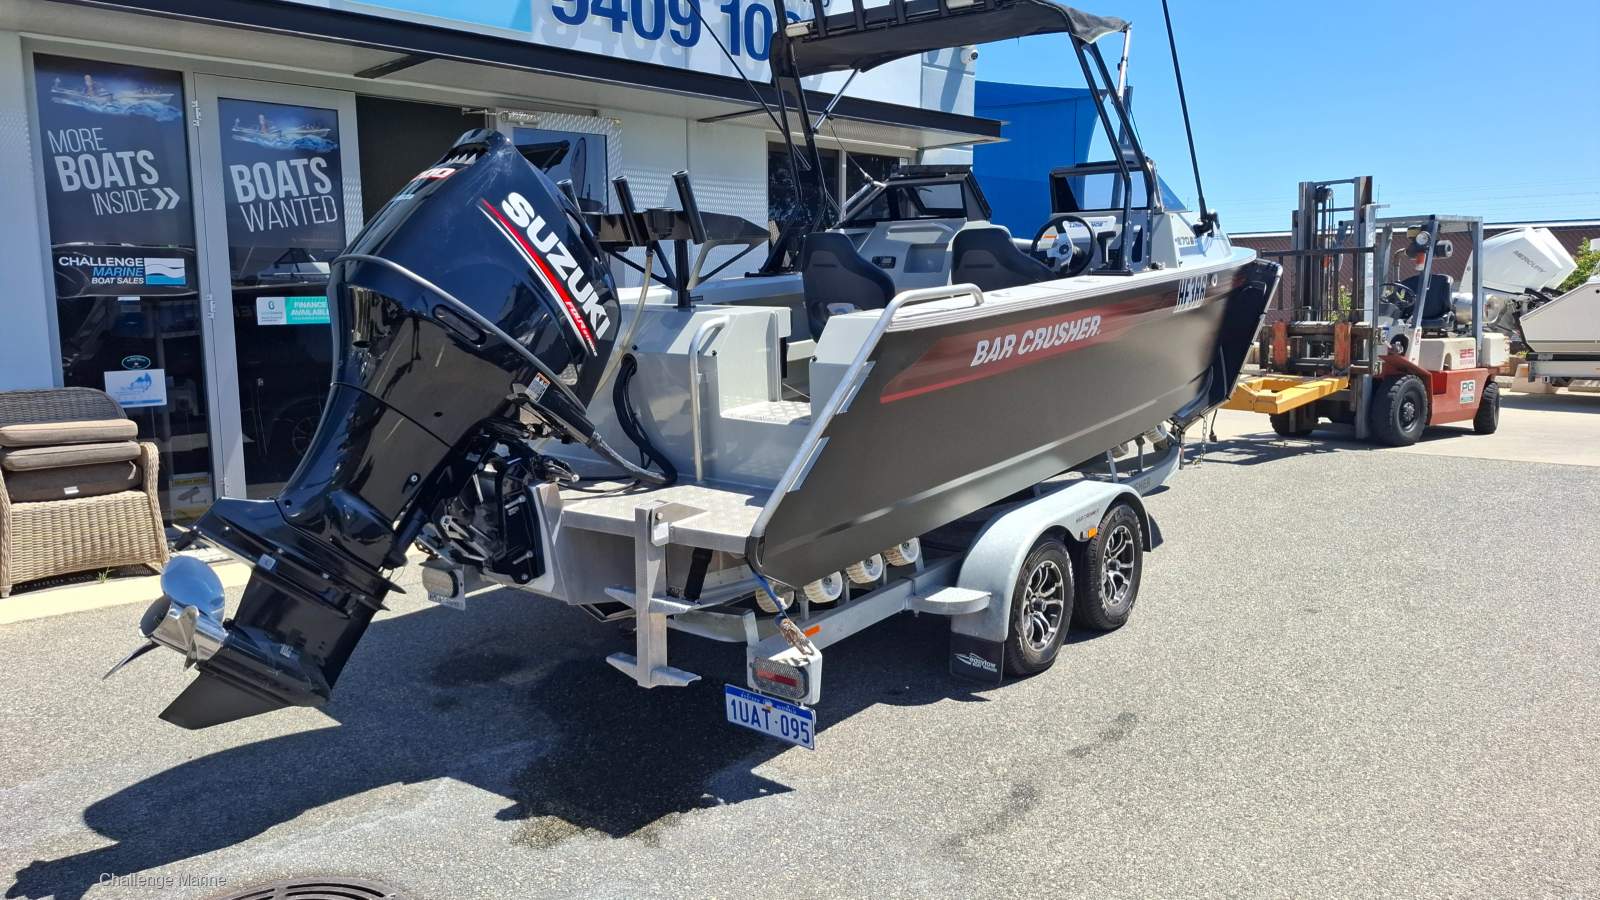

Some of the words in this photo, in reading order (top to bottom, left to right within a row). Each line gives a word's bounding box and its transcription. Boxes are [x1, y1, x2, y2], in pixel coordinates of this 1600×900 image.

[47, 127, 104, 154] MORE
[54, 149, 160, 193] BOATS
[229, 156, 333, 205] BOATS
[92, 187, 154, 216] INSIDE
[240, 195, 338, 233] WANTED
[58, 256, 145, 268] CHALLENGE
[93, 266, 145, 278] MARINE
[501, 191, 611, 340] SUZUKI
[91, 276, 117, 285] BOAT
[117, 277, 145, 285] SALES
[294, 301, 328, 309] FINANCE
[969, 334, 1015, 367] BAR
[1016, 315, 1101, 356] CRUSHER
